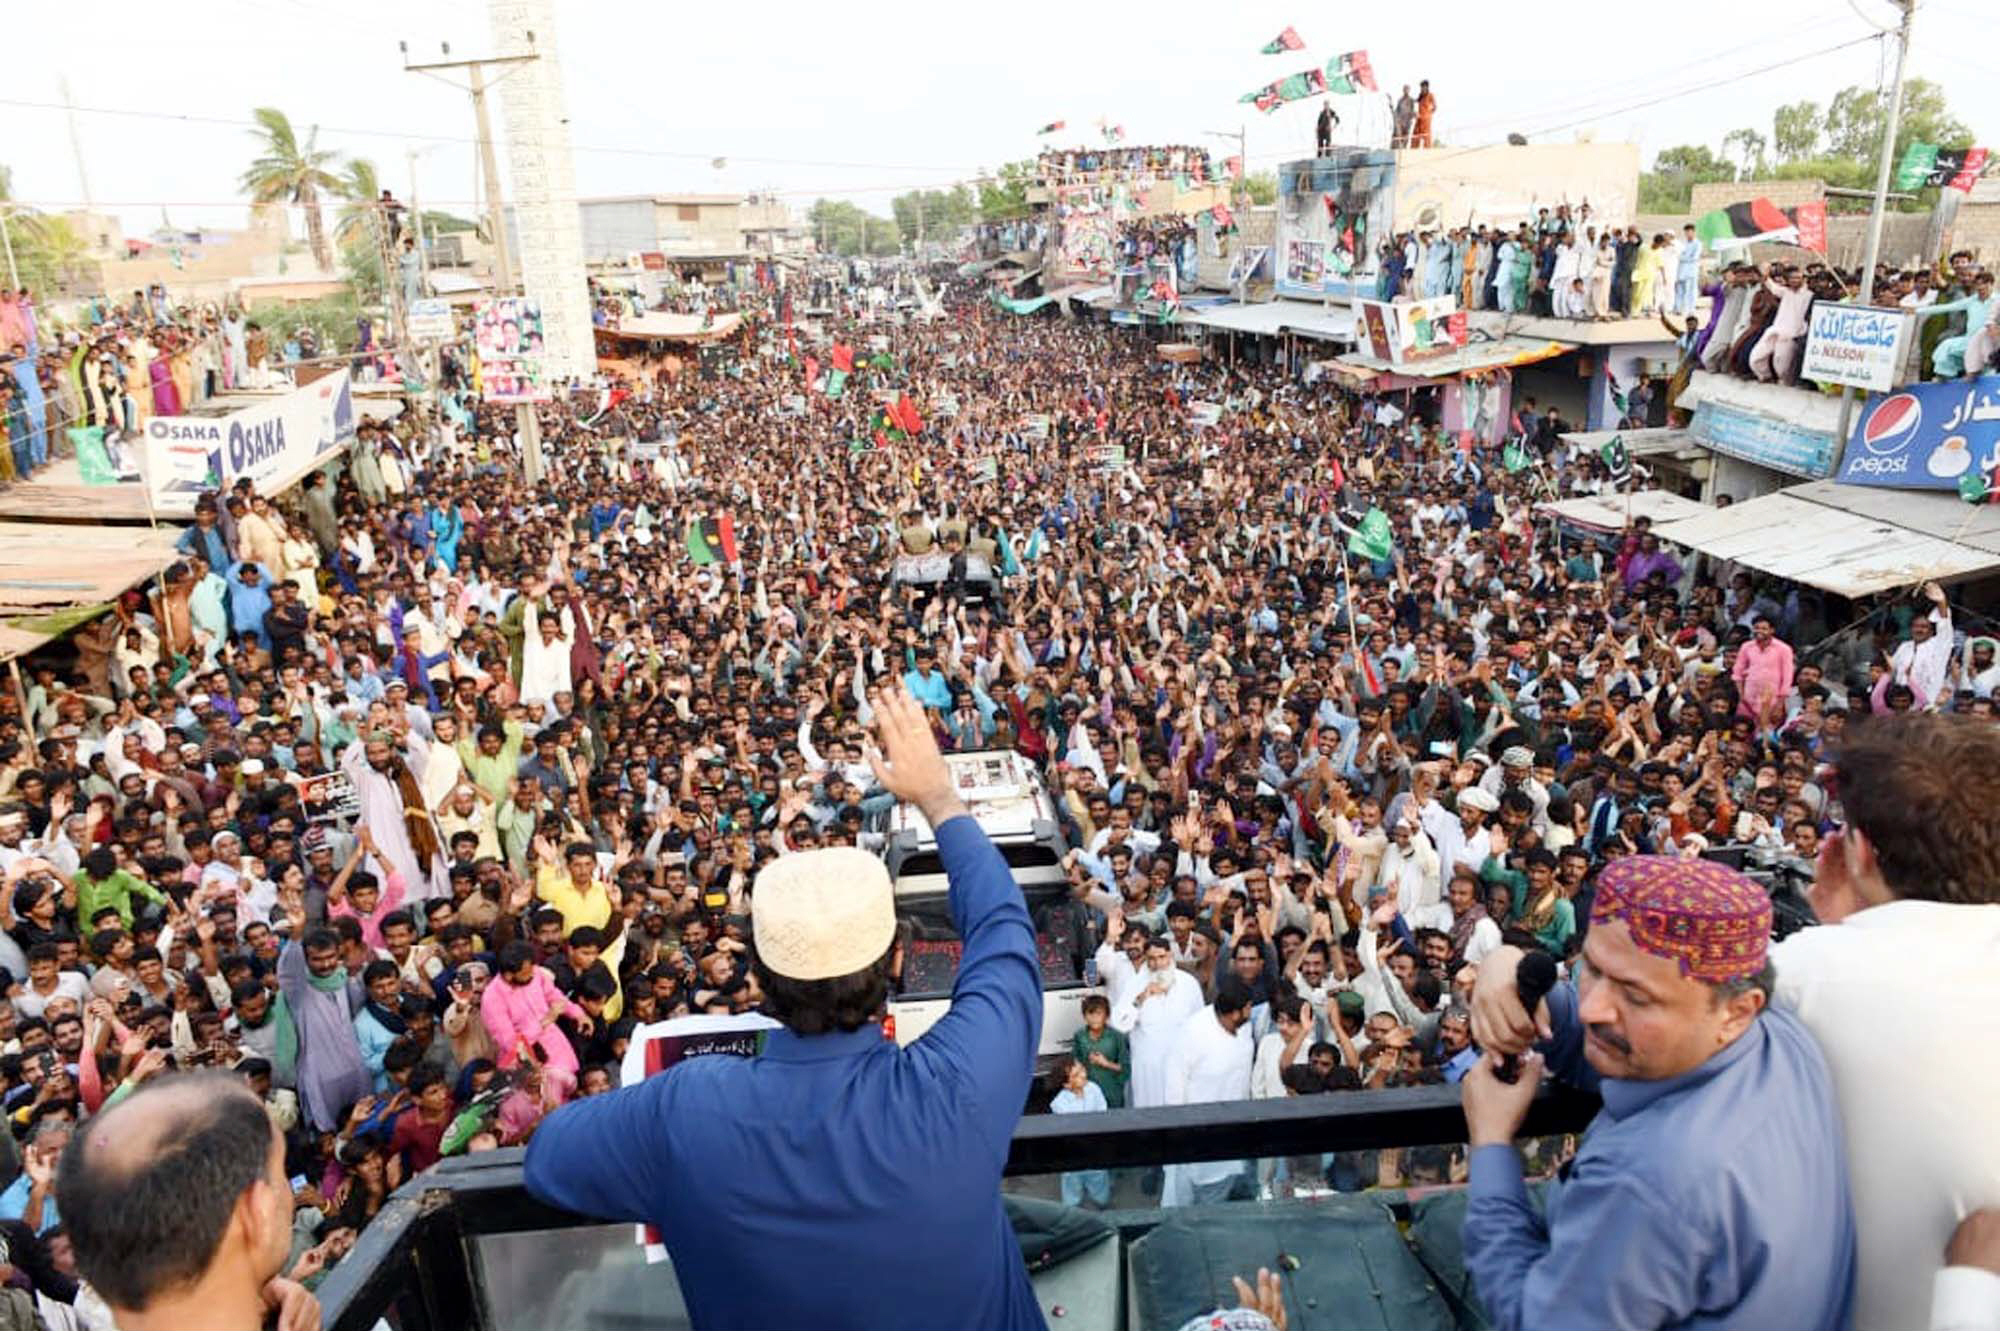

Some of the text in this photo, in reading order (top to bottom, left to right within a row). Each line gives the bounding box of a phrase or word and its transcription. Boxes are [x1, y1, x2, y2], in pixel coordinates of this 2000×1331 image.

[150, 421, 221, 440] OSAKA
[229, 416, 287, 474] OSAKA
[1848, 454, 1910, 476] pepsi
